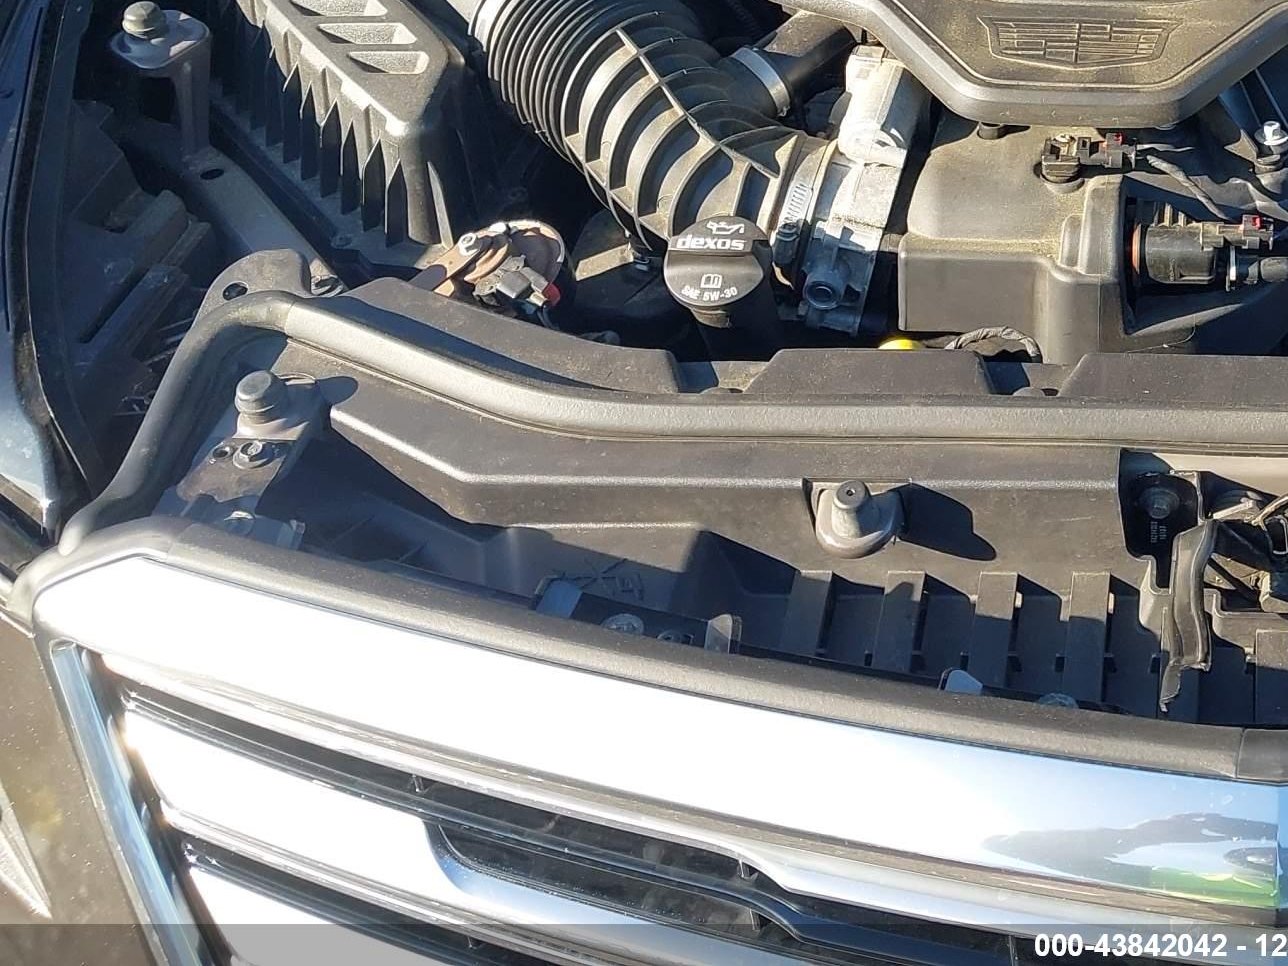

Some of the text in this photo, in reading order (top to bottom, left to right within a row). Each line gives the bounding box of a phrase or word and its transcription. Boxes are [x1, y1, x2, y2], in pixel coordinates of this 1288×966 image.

[676, 234, 745, 251] dexos
[681, 285, 738, 302] SAE 5W-30
